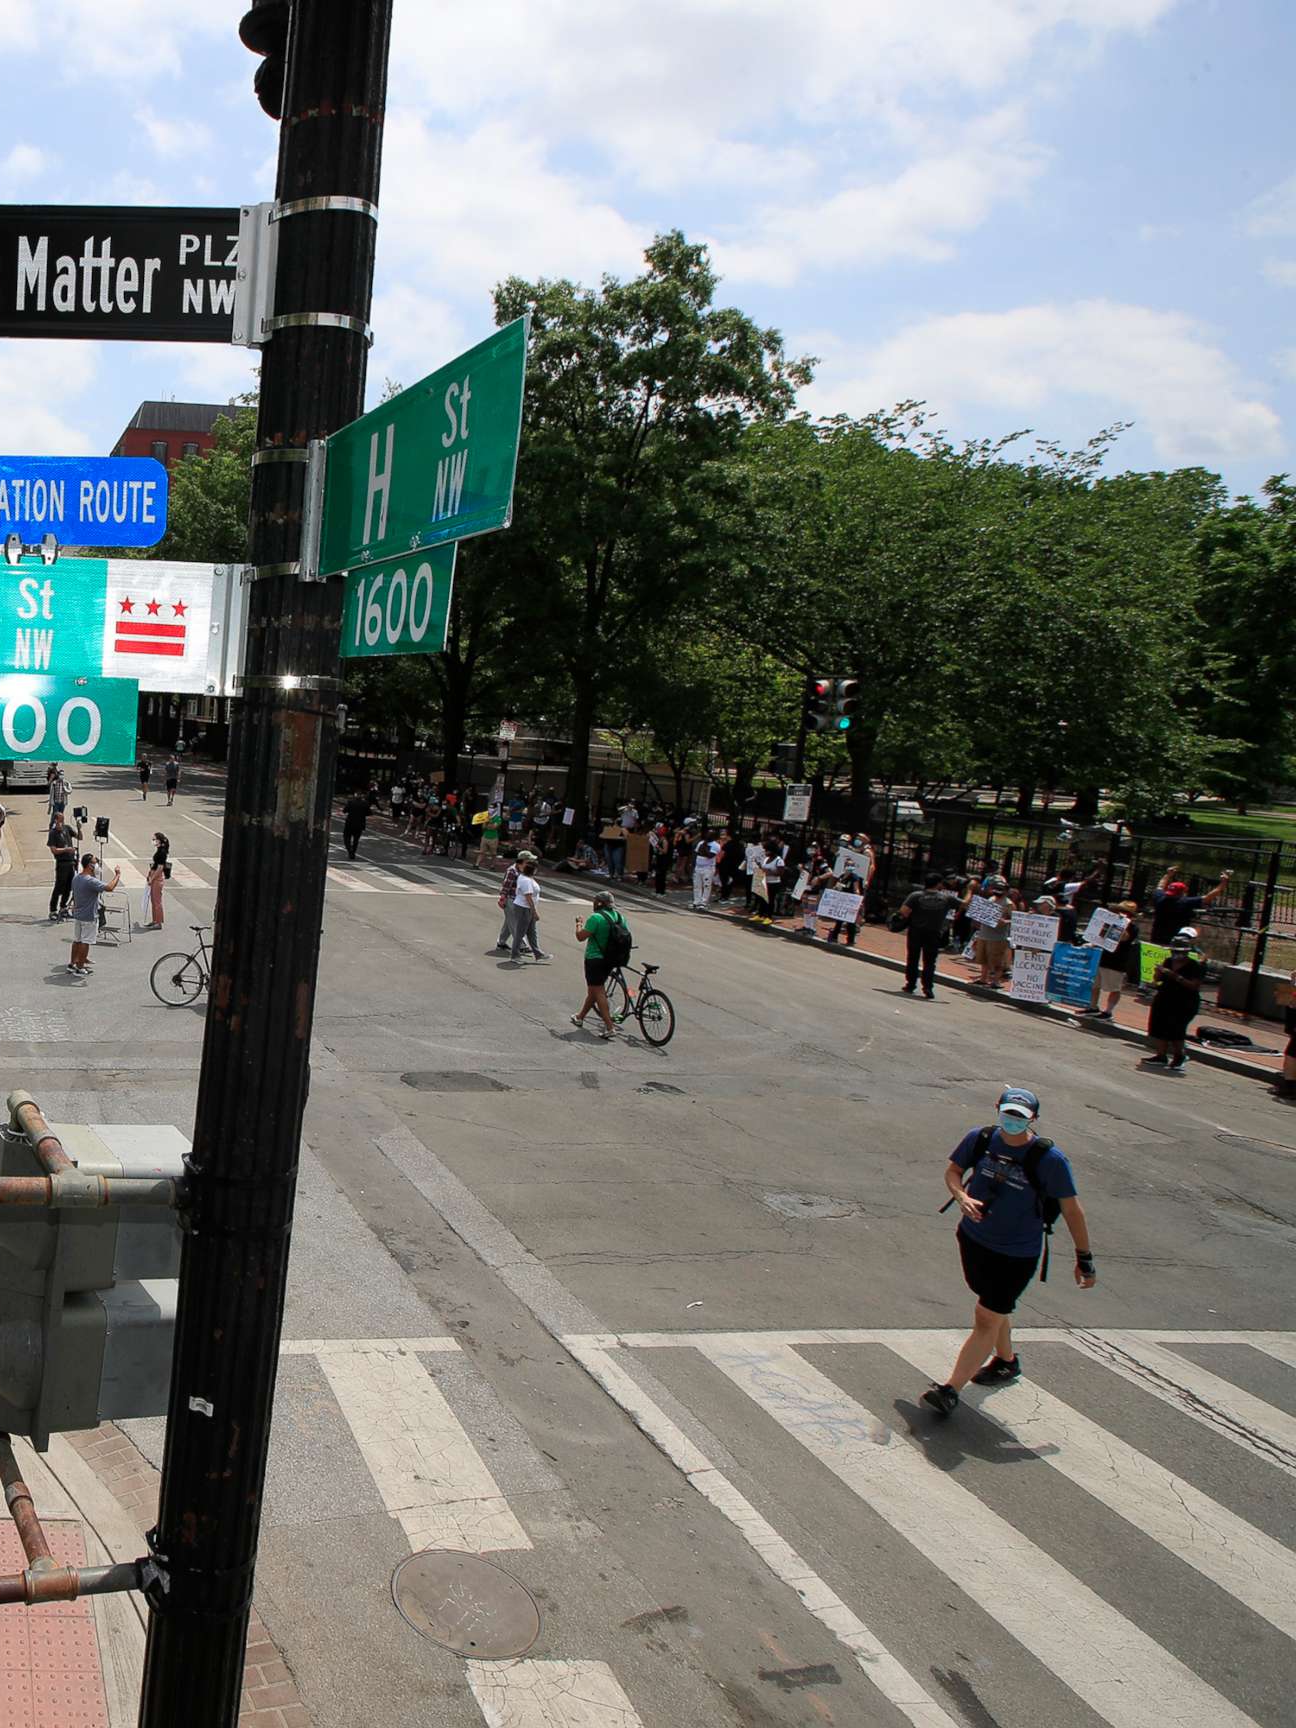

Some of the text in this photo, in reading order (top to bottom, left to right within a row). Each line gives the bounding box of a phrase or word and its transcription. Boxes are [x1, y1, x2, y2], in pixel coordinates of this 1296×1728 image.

[179, 233, 239, 267] PLZ
[16, 236, 161, 314] Matter
[182, 278, 235, 315] NW
[363, 375, 471, 546] H St
[80, 480, 157, 526] ROUTE
[433, 450, 466, 519] NW
[18, 578, 54, 619] St
[355, 561, 432, 647] 1600
[15, 629, 52, 670] NW
